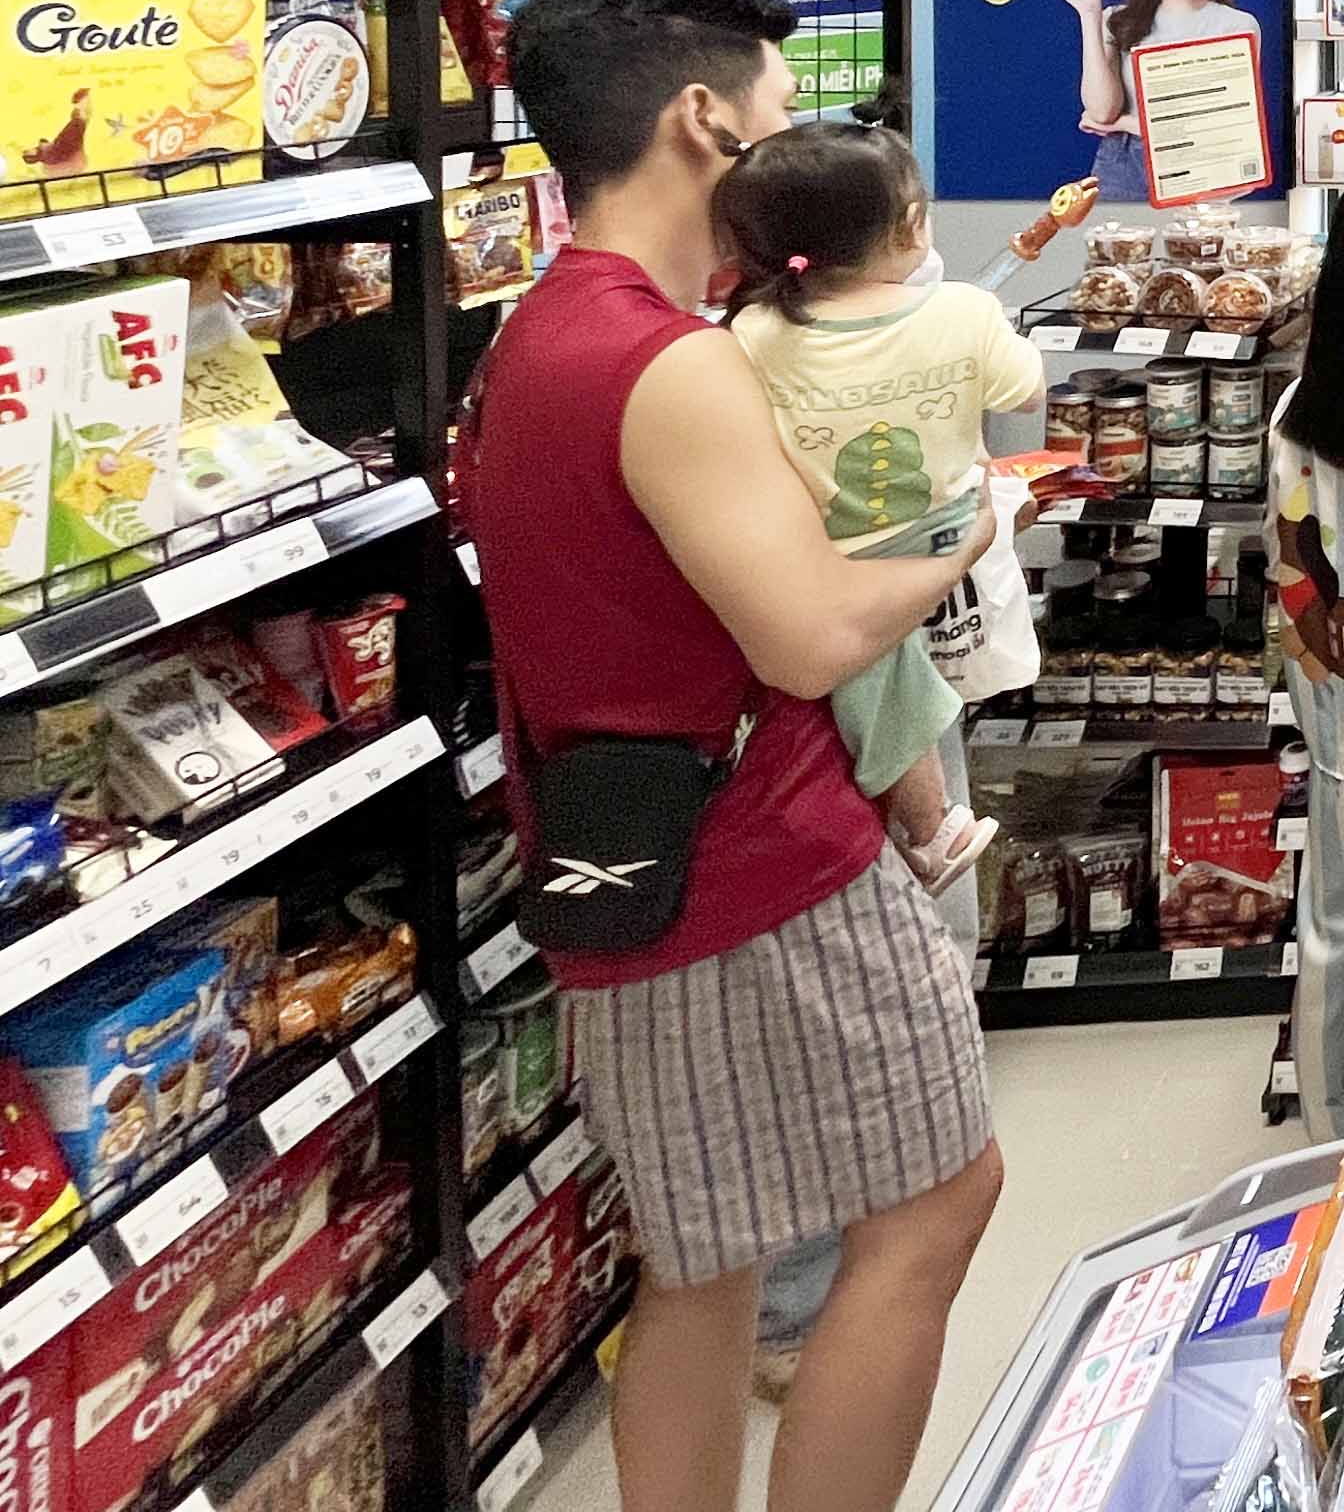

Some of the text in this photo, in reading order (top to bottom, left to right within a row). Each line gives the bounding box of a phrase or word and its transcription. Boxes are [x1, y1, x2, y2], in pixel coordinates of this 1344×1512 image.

[16, 2, 179, 54] Gouté
[112, 310, 163, 389] AFC
[770, 356, 979, 412] DINOSAUR
